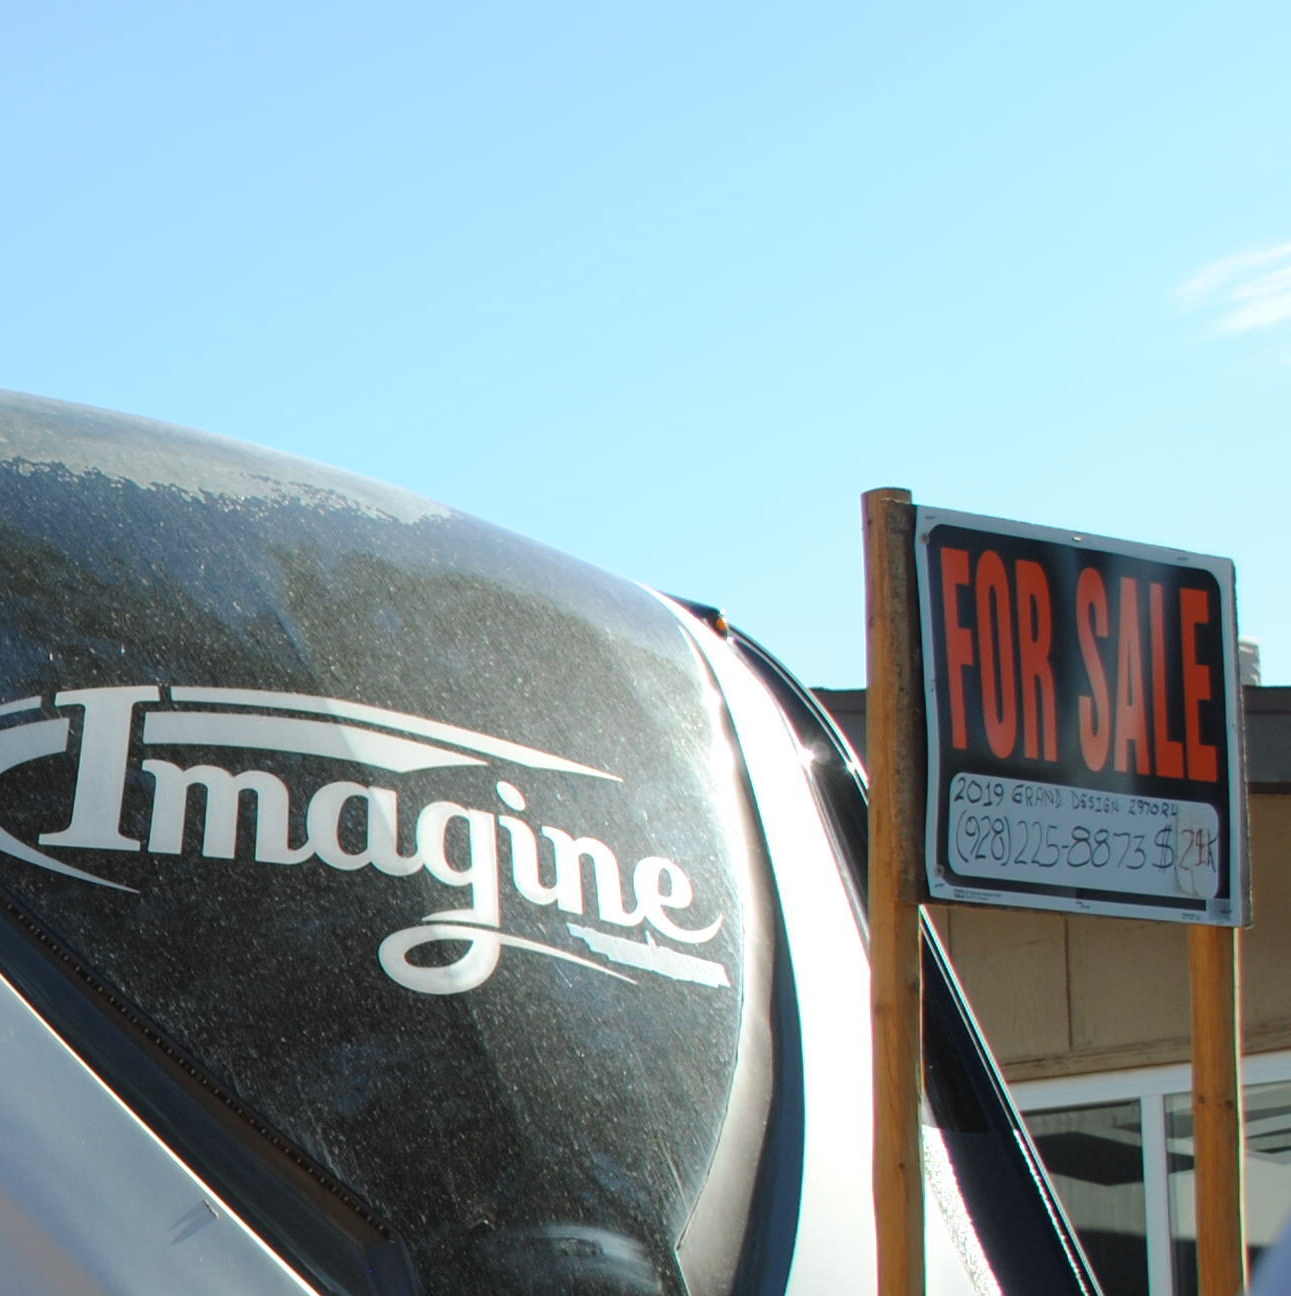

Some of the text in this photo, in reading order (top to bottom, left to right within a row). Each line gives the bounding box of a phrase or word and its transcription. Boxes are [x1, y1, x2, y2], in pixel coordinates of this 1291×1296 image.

[940, 547, 1218, 782] FOR SALE
[36, 685, 724, 996] Imagine
[954, 776, 1005, 807] 2019
[1011, 783, 1062, 809] GRAND
[1071, 790, 1119, 814] DESIGN
